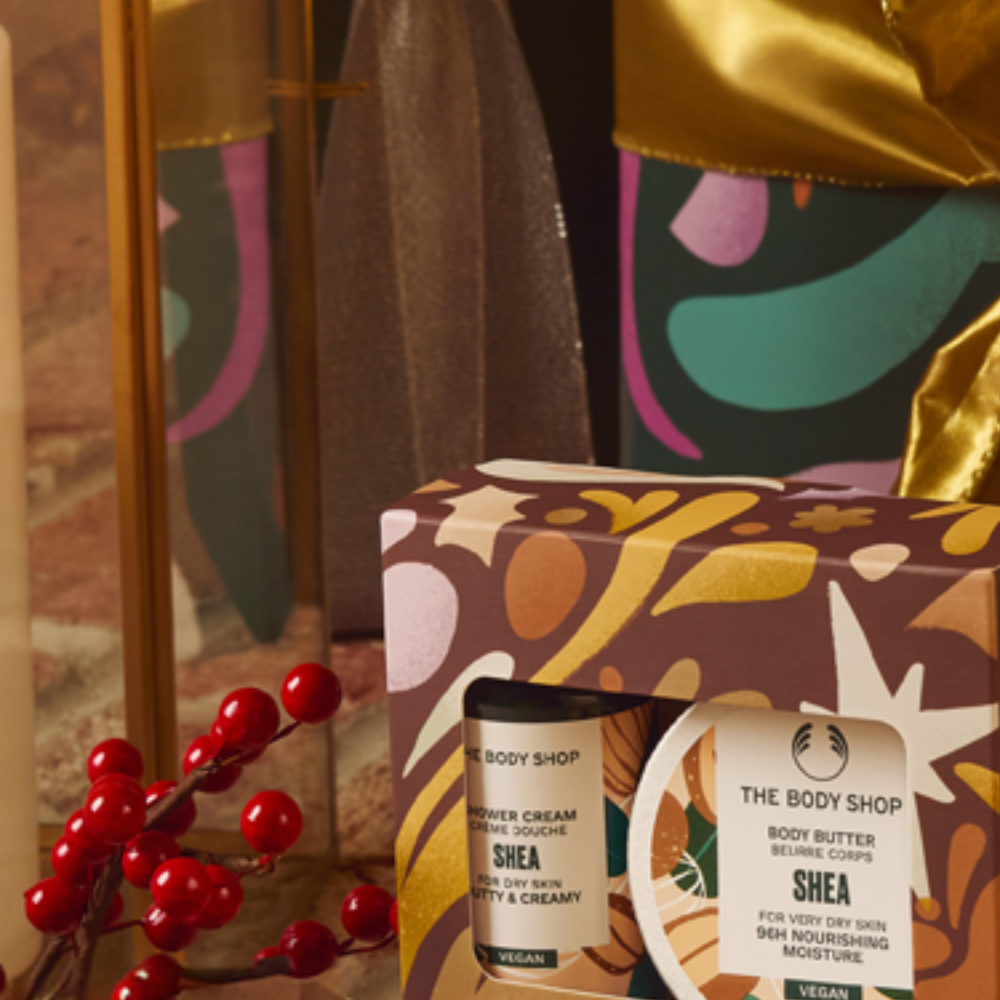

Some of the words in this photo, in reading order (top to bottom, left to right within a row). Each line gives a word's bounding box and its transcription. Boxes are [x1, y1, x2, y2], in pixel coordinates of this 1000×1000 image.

[464, 748, 481, 764] HE
[485, 749, 529, 766] BODY
[533, 750, 580, 766] SHOP
[741, 786, 780, 806] THE
[786, 789, 842, 811] BODY
[846, 793, 903, 816] SHOP
[522, 809, 577, 823] CREAM
[513, 824, 569, 838] DOUCHE
[767, 826, 810, 842] BODY
[813, 829, 876, 848] BUTTER
[493, 843, 541, 871] SHEA
[771, 843, 824, 860] BEURRE
[828, 848, 873, 864] CORPS
[477, 874, 499, 887] FOR
[504, 877, 528, 889] DRY
[532, 879, 562, 890] SKIN
[793, 868, 852, 907] SHEA
[471, 886, 504, 903] UTTY
[508, 893, 517, 904] &
[520, 890, 582, 905] CREAMY
[759, 910, 785, 924] FOR
[788, 914, 822, 927] VERY
[826, 916, 853, 929] DRY
[855, 919, 887, 933] SKIN
[756, 925, 787, 942] 96H
[791, 929, 889, 950] NOURISHING
[498, 951, 546, 965] VEGAN
[783, 945, 864, 964] MOISTURE
[798, 984, 850, 1000] VEGAN
